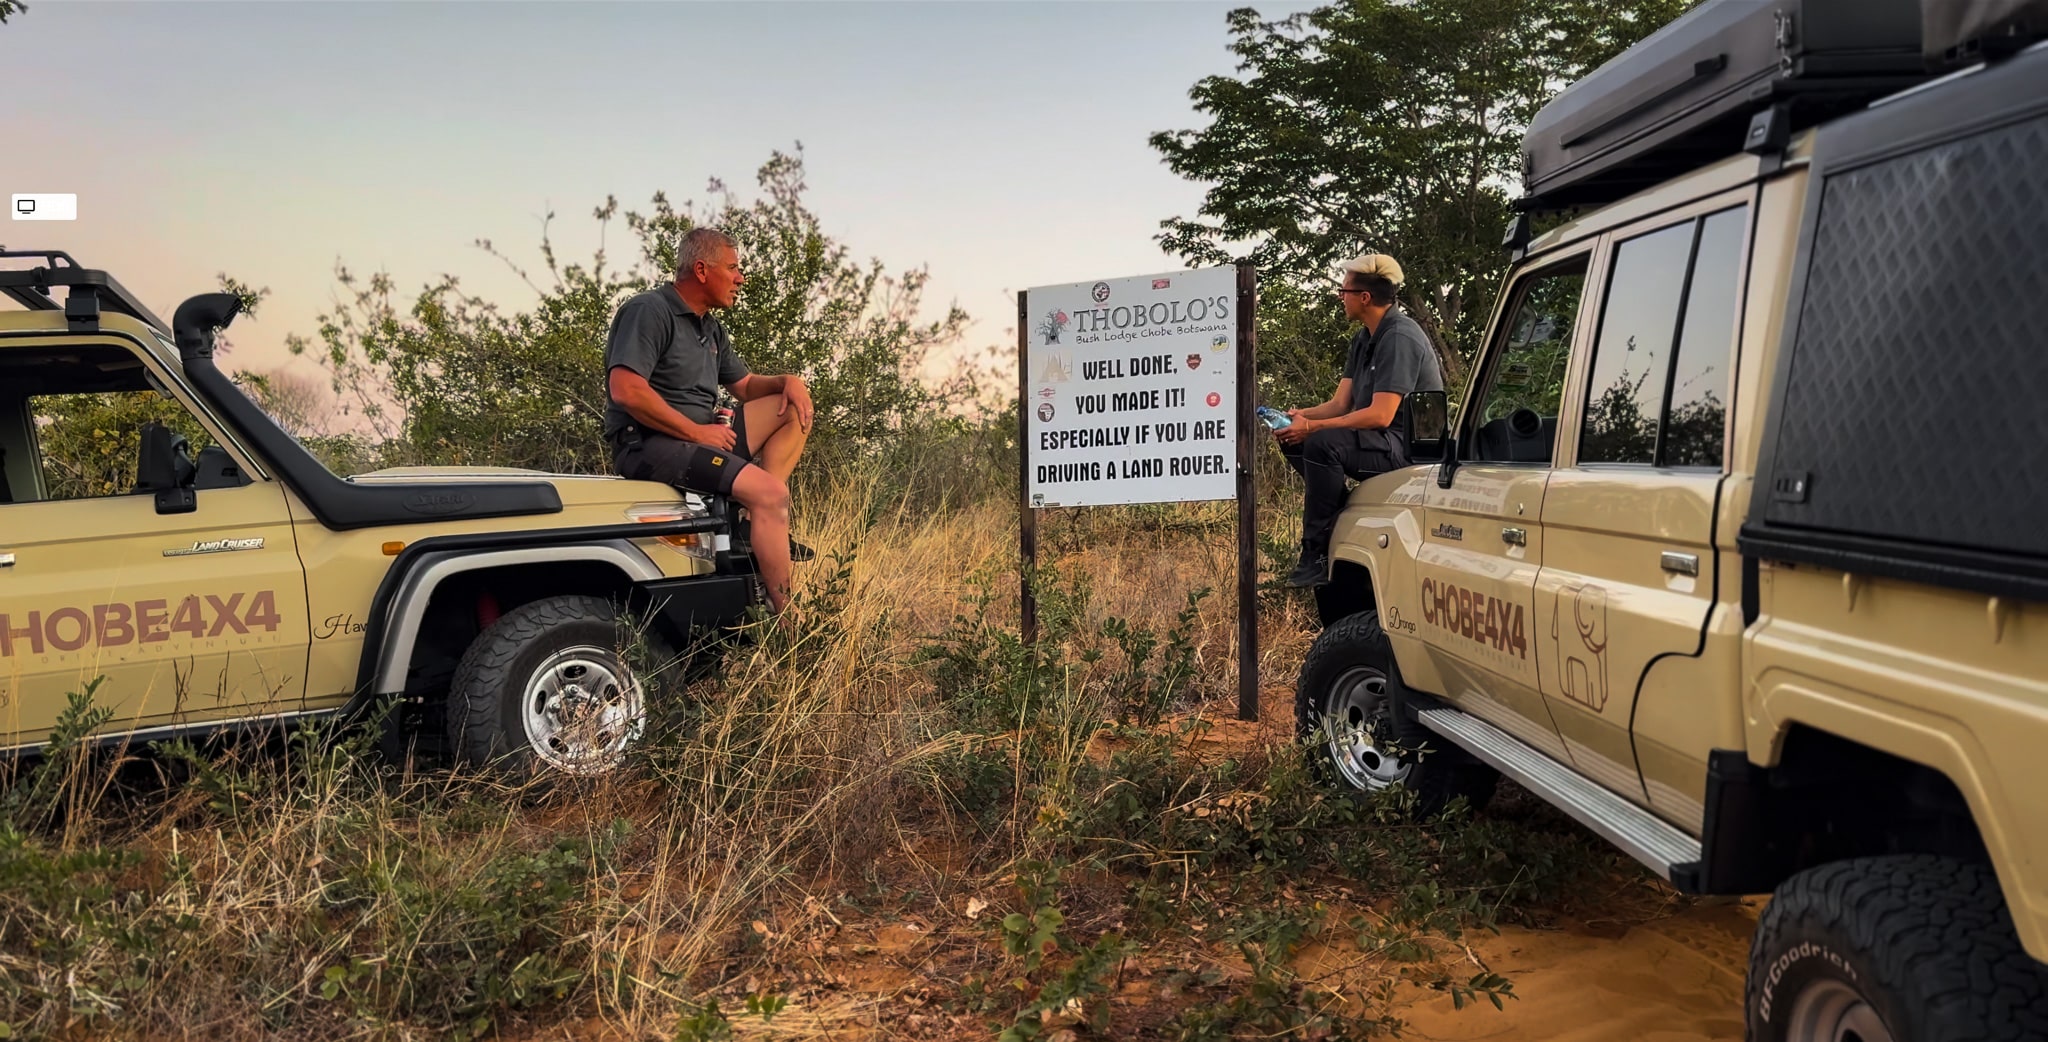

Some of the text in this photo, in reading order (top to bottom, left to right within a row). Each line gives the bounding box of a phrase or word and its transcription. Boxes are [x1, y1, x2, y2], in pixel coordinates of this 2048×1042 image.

[1073, 295, 1229, 333] THOBOLO'S
[1076, 323, 1228, 345] Bush Lodge Chobe Botswana
[1082, 359, 1124, 381] WELL
[1130, 354, 1178, 377] DONE,
[1075, 394, 1106, 415] YOU
[1112, 390, 1159, 412] MADE
[1165, 387, 1186, 408] IT!
[1040, 419, 1226, 451] ESPECIALLY IF YOU ARE
[1037, 454, 1230, 484] DRIVING A LAND ROVER.
[0, 590, 281, 657] HOBE4X4
[1421, 577, 1527, 660] CHOBE4X4
[1759, 941, 1857, 1023] BFGoodrich
